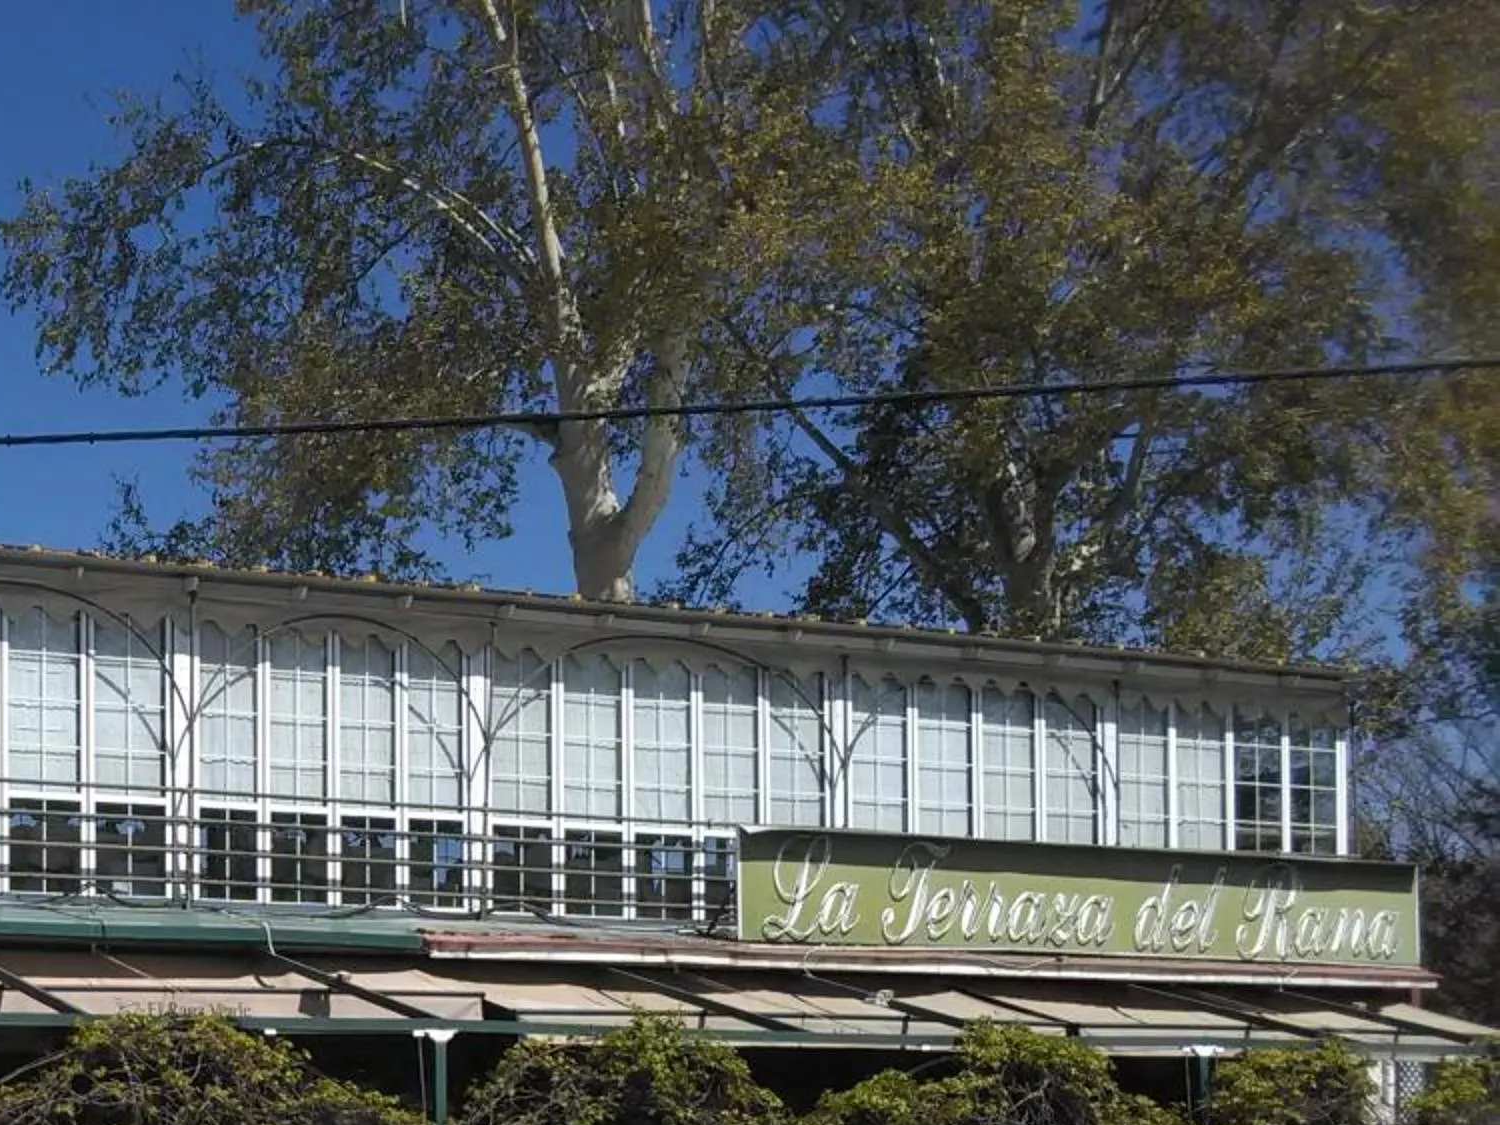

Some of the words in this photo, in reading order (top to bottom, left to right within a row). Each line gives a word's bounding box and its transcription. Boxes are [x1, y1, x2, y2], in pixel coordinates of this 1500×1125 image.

[762, 835, 860, 941] La
[881, 841, 1114, 947] Terraza
[1133, 863, 1226, 953] del
[1235, 863, 1399, 960] Rana
